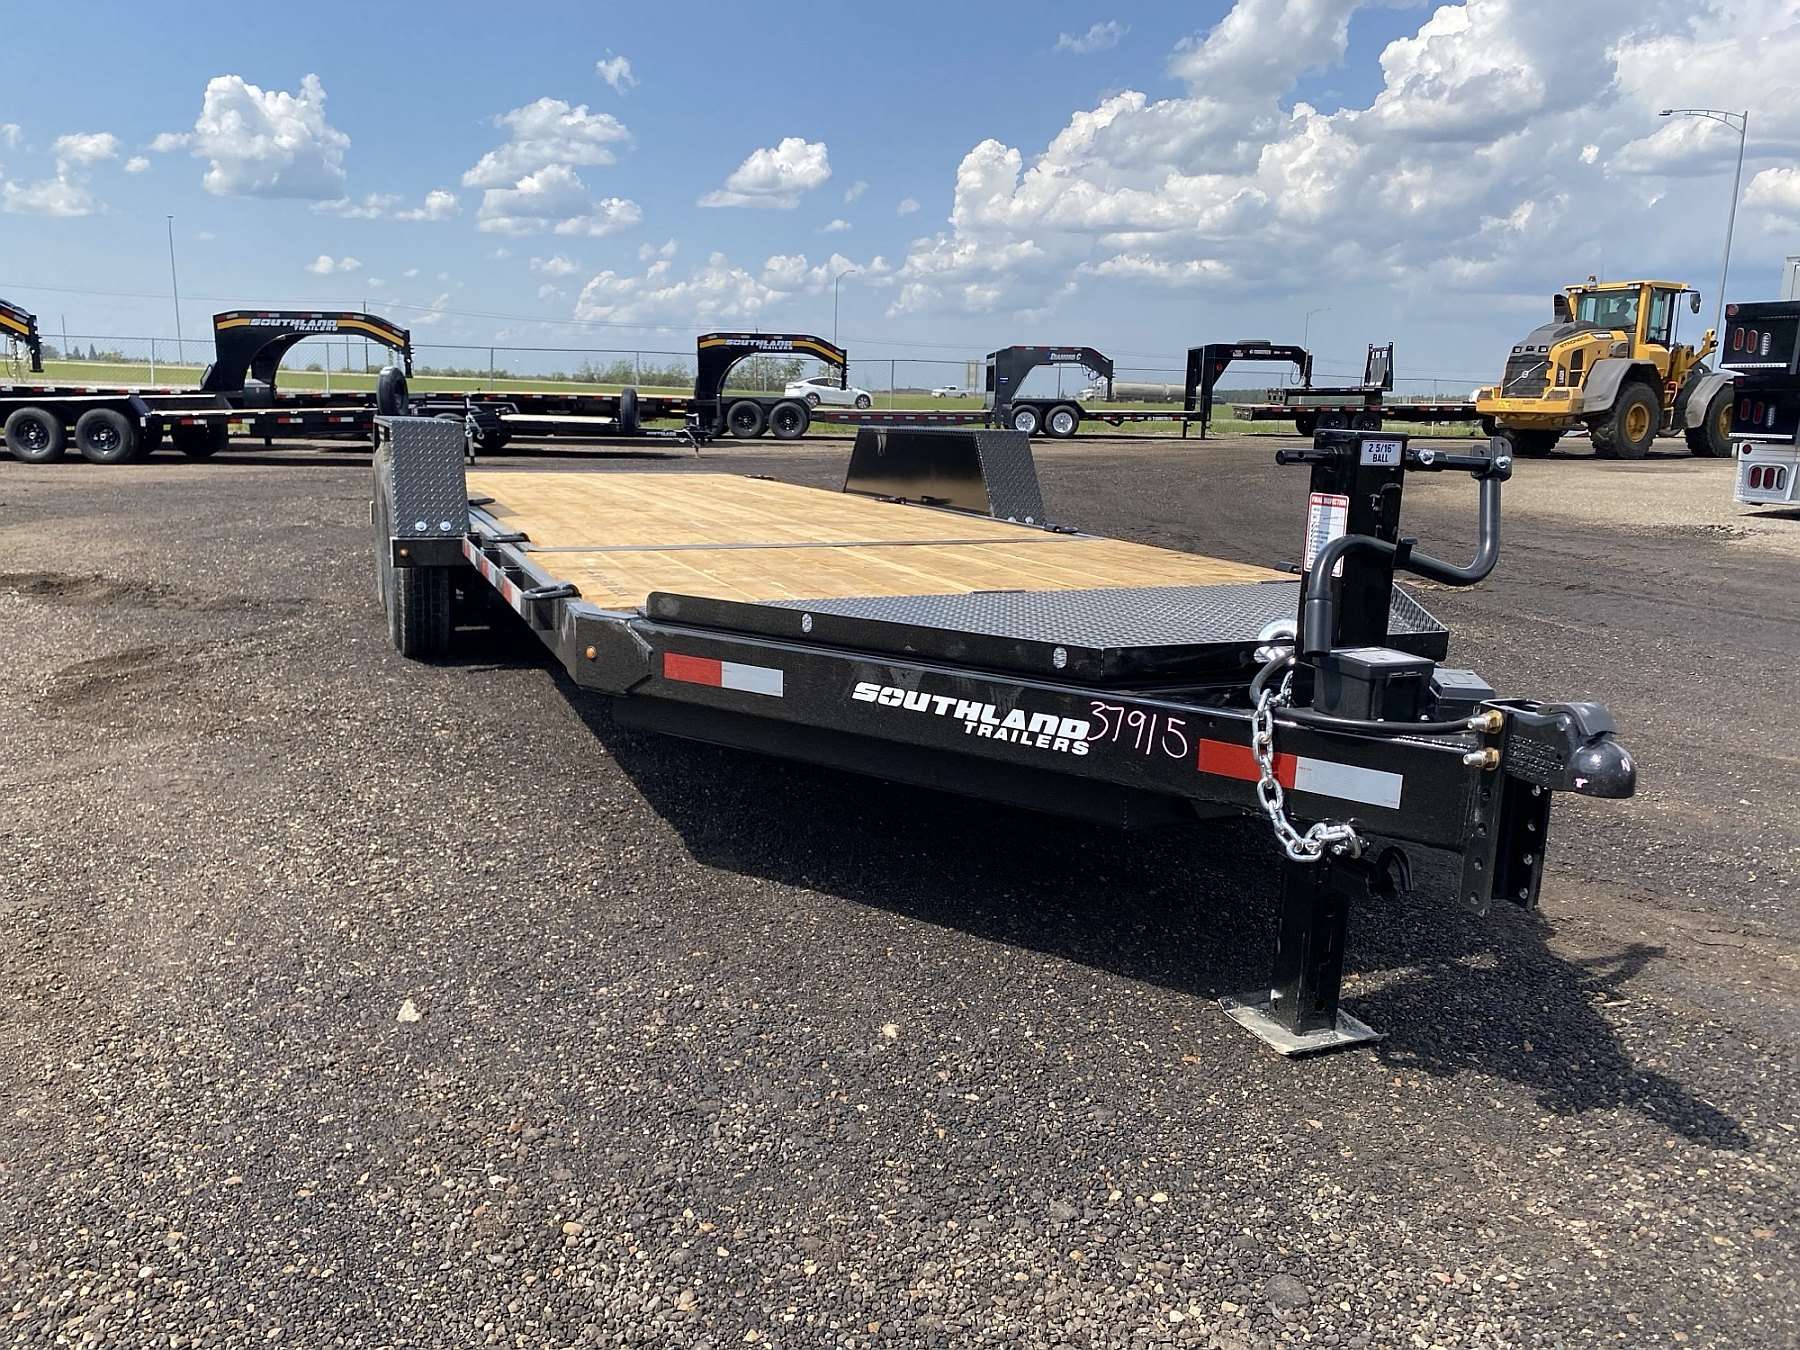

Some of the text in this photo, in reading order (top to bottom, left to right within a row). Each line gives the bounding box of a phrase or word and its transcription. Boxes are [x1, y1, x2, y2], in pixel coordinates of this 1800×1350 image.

[250, 318, 337, 326] SOUTHLAND
[1368, 443, 1374, 453] 2
[1372, 453, 1389, 463] BALL
[851, 681, 1090, 741] SOUTHLAND
[964, 720, 1090, 756] TRAILERS
[1086, 701, 1188, 759] 37915
